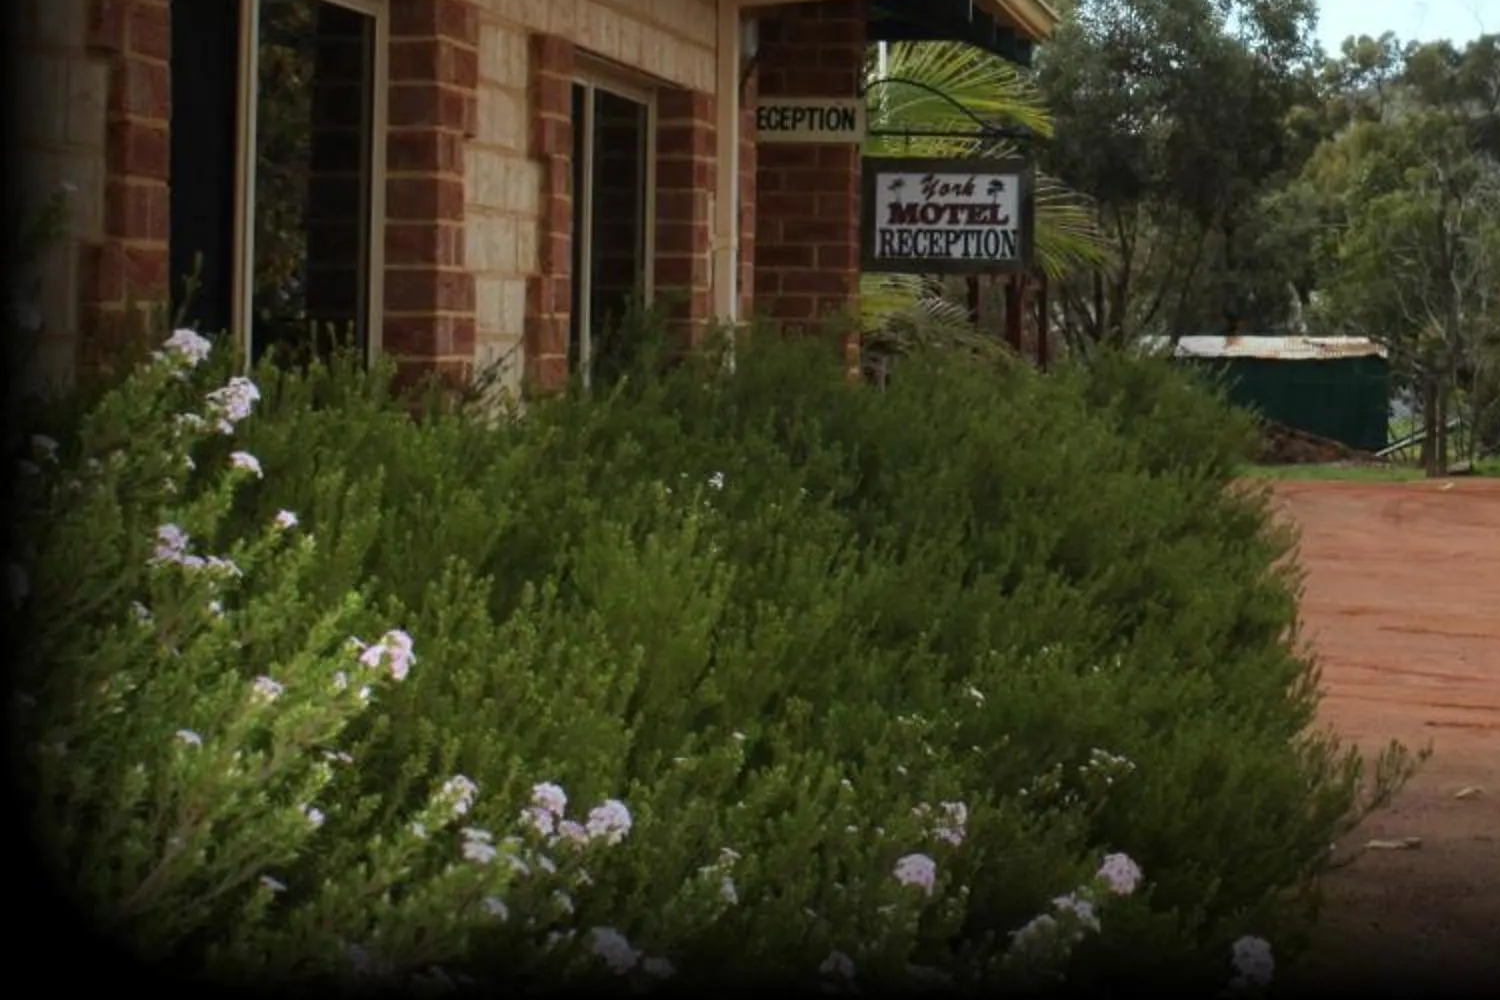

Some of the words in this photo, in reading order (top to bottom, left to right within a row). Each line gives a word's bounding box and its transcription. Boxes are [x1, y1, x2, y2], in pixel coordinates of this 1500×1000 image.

[756, 106, 857, 132] ECEPTION
[920, 173, 976, 200] York
[887, 202, 1009, 225] MOTEL
[878, 227, 1019, 258] RECEPTION
